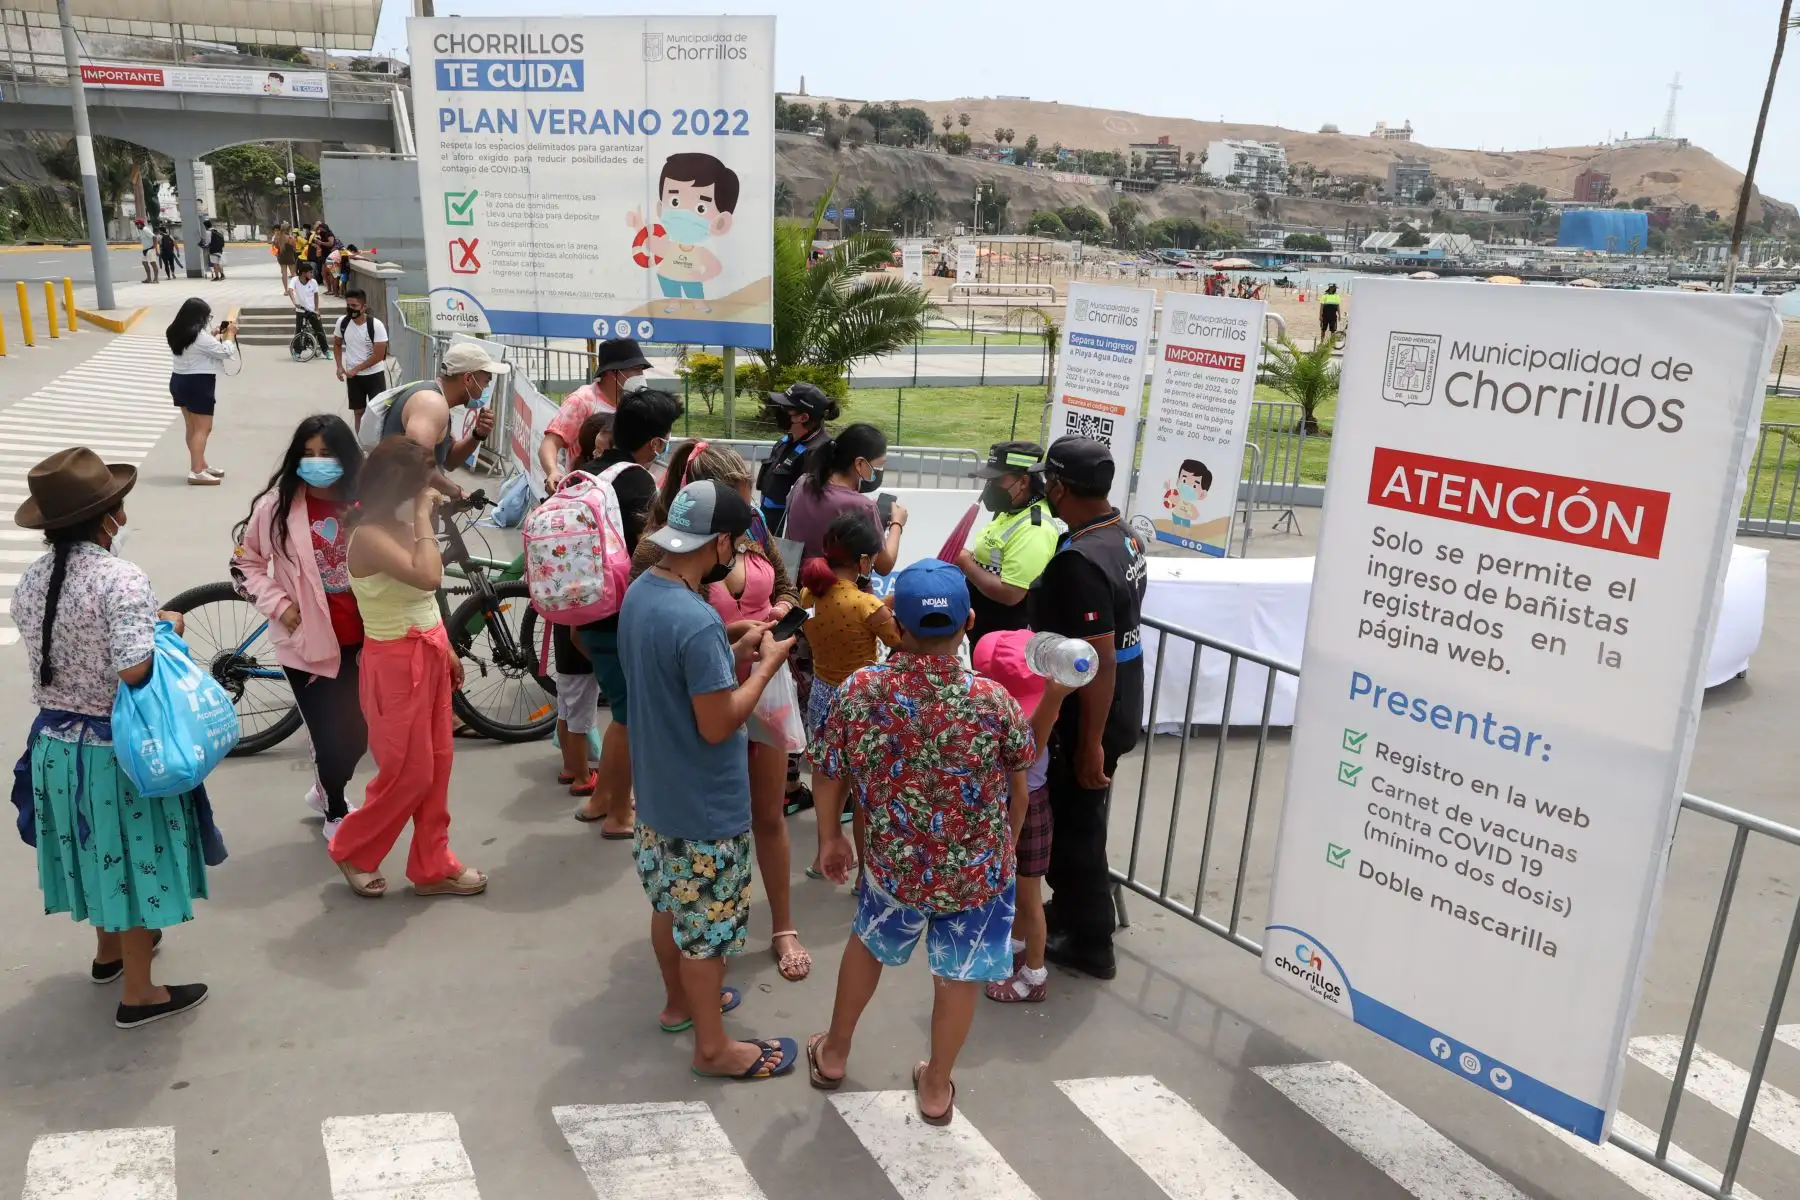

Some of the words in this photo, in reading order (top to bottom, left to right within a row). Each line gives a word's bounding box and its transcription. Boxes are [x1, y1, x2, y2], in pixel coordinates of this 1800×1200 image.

[434, 34, 584, 54] CHORRILLOS
[667, 34, 731, 43] Municipalidad
[735, 34, 747, 42] de
[667, 44, 747, 60] Chorrillos
[83, 70, 161, 82] IMPORTANTE
[444, 64, 478, 87] TE
[487, 64, 577, 88] CUIDA
[440, 108, 517, 133] PLAN
[526, 109, 661, 135] VERANO
[672, 109, 749, 136] 2022
[441, 142, 472, 151] Respeta
[489, 143, 525, 152] espacios
[527, 143, 575, 151] delimitados
[579, 145, 596, 153] para
[600, 145, 643, 154] garantizar
[479, 154, 508, 164] exigido
[514, 156, 532, 164] para
[572, 156, 627, 166] posibilidades
[442, 166, 476, 175] contagio
[485, 191, 502, 199] Para
[501, 221, 548, 229] desperdicios
[564, 213, 599, 221] depositar
[491, 240, 515, 248] Ingerir
[436, 312, 478, 321] chorrillos
[1089, 311, 1137, 326] Chorrillos
[1188, 323, 1246, 341] Chorrillos
[1072, 335, 1094, 345] Separa
[1106, 340, 1134, 351] ingreso
[1075, 349, 1091, 358] Playa
[1094, 352, 1110, 361] Agua
[1113, 355, 1132, 364] Dulce
[1168, 348, 1241, 368] IMPORTANTE
[1450, 341, 1641, 377] Municipalidad
[1651, 356, 1693, 382] de
[1193, 372, 1202, 380] del
[1206, 375, 1228, 383] viernes
[1445, 370, 1685, 433] Chorrillos
[1381, 466, 1644, 545] ATENCIÓN
[1372, 526, 1423, 555] Solo
[1436, 543, 1463, 564] se
[1477, 552, 1591, 592] permite
[1608, 577, 1636, 601] el
[922, 598, 948, 606] INDIAN
[1367, 555, 1456, 595] ingreso
[1464, 580, 1497, 604] de
[1505, 587, 1629, 635] bañistas
[1363, 587, 1504, 639] registrados
[1531, 632, 1566, 655] en
[1598, 642, 1622, 668] la
[1359, 618, 1438, 654] página
[1448, 642, 1511, 674] web.
[1350, 671, 1551, 762] Presentar:
[1376, 742, 1463, 789] Registro
[1472, 779, 1498, 799] en
[1507, 786, 1527, 808] la
[1536, 798, 1590, 828] web
[1371, 776, 1439, 815] Carnet
[1446, 803, 1473, 826] de
[1480, 817, 1578, 863] vacunas
[1368, 802, 1432, 837] contra
[1439, 827, 1513, 866] COVID
[1521, 855, 1543, 877] 19
[1364, 821, 1448, 867] (mínimo
[1455, 859, 1494, 886] dos
[1502, 878, 1572, 917] dosis)
[1358, 860, 1423, 902] Doble
[1431, 893, 1558, 958] mascarilla
[1296, 944, 1321, 971] Ch
[1275, 957, 1340, 996] chorrillos
